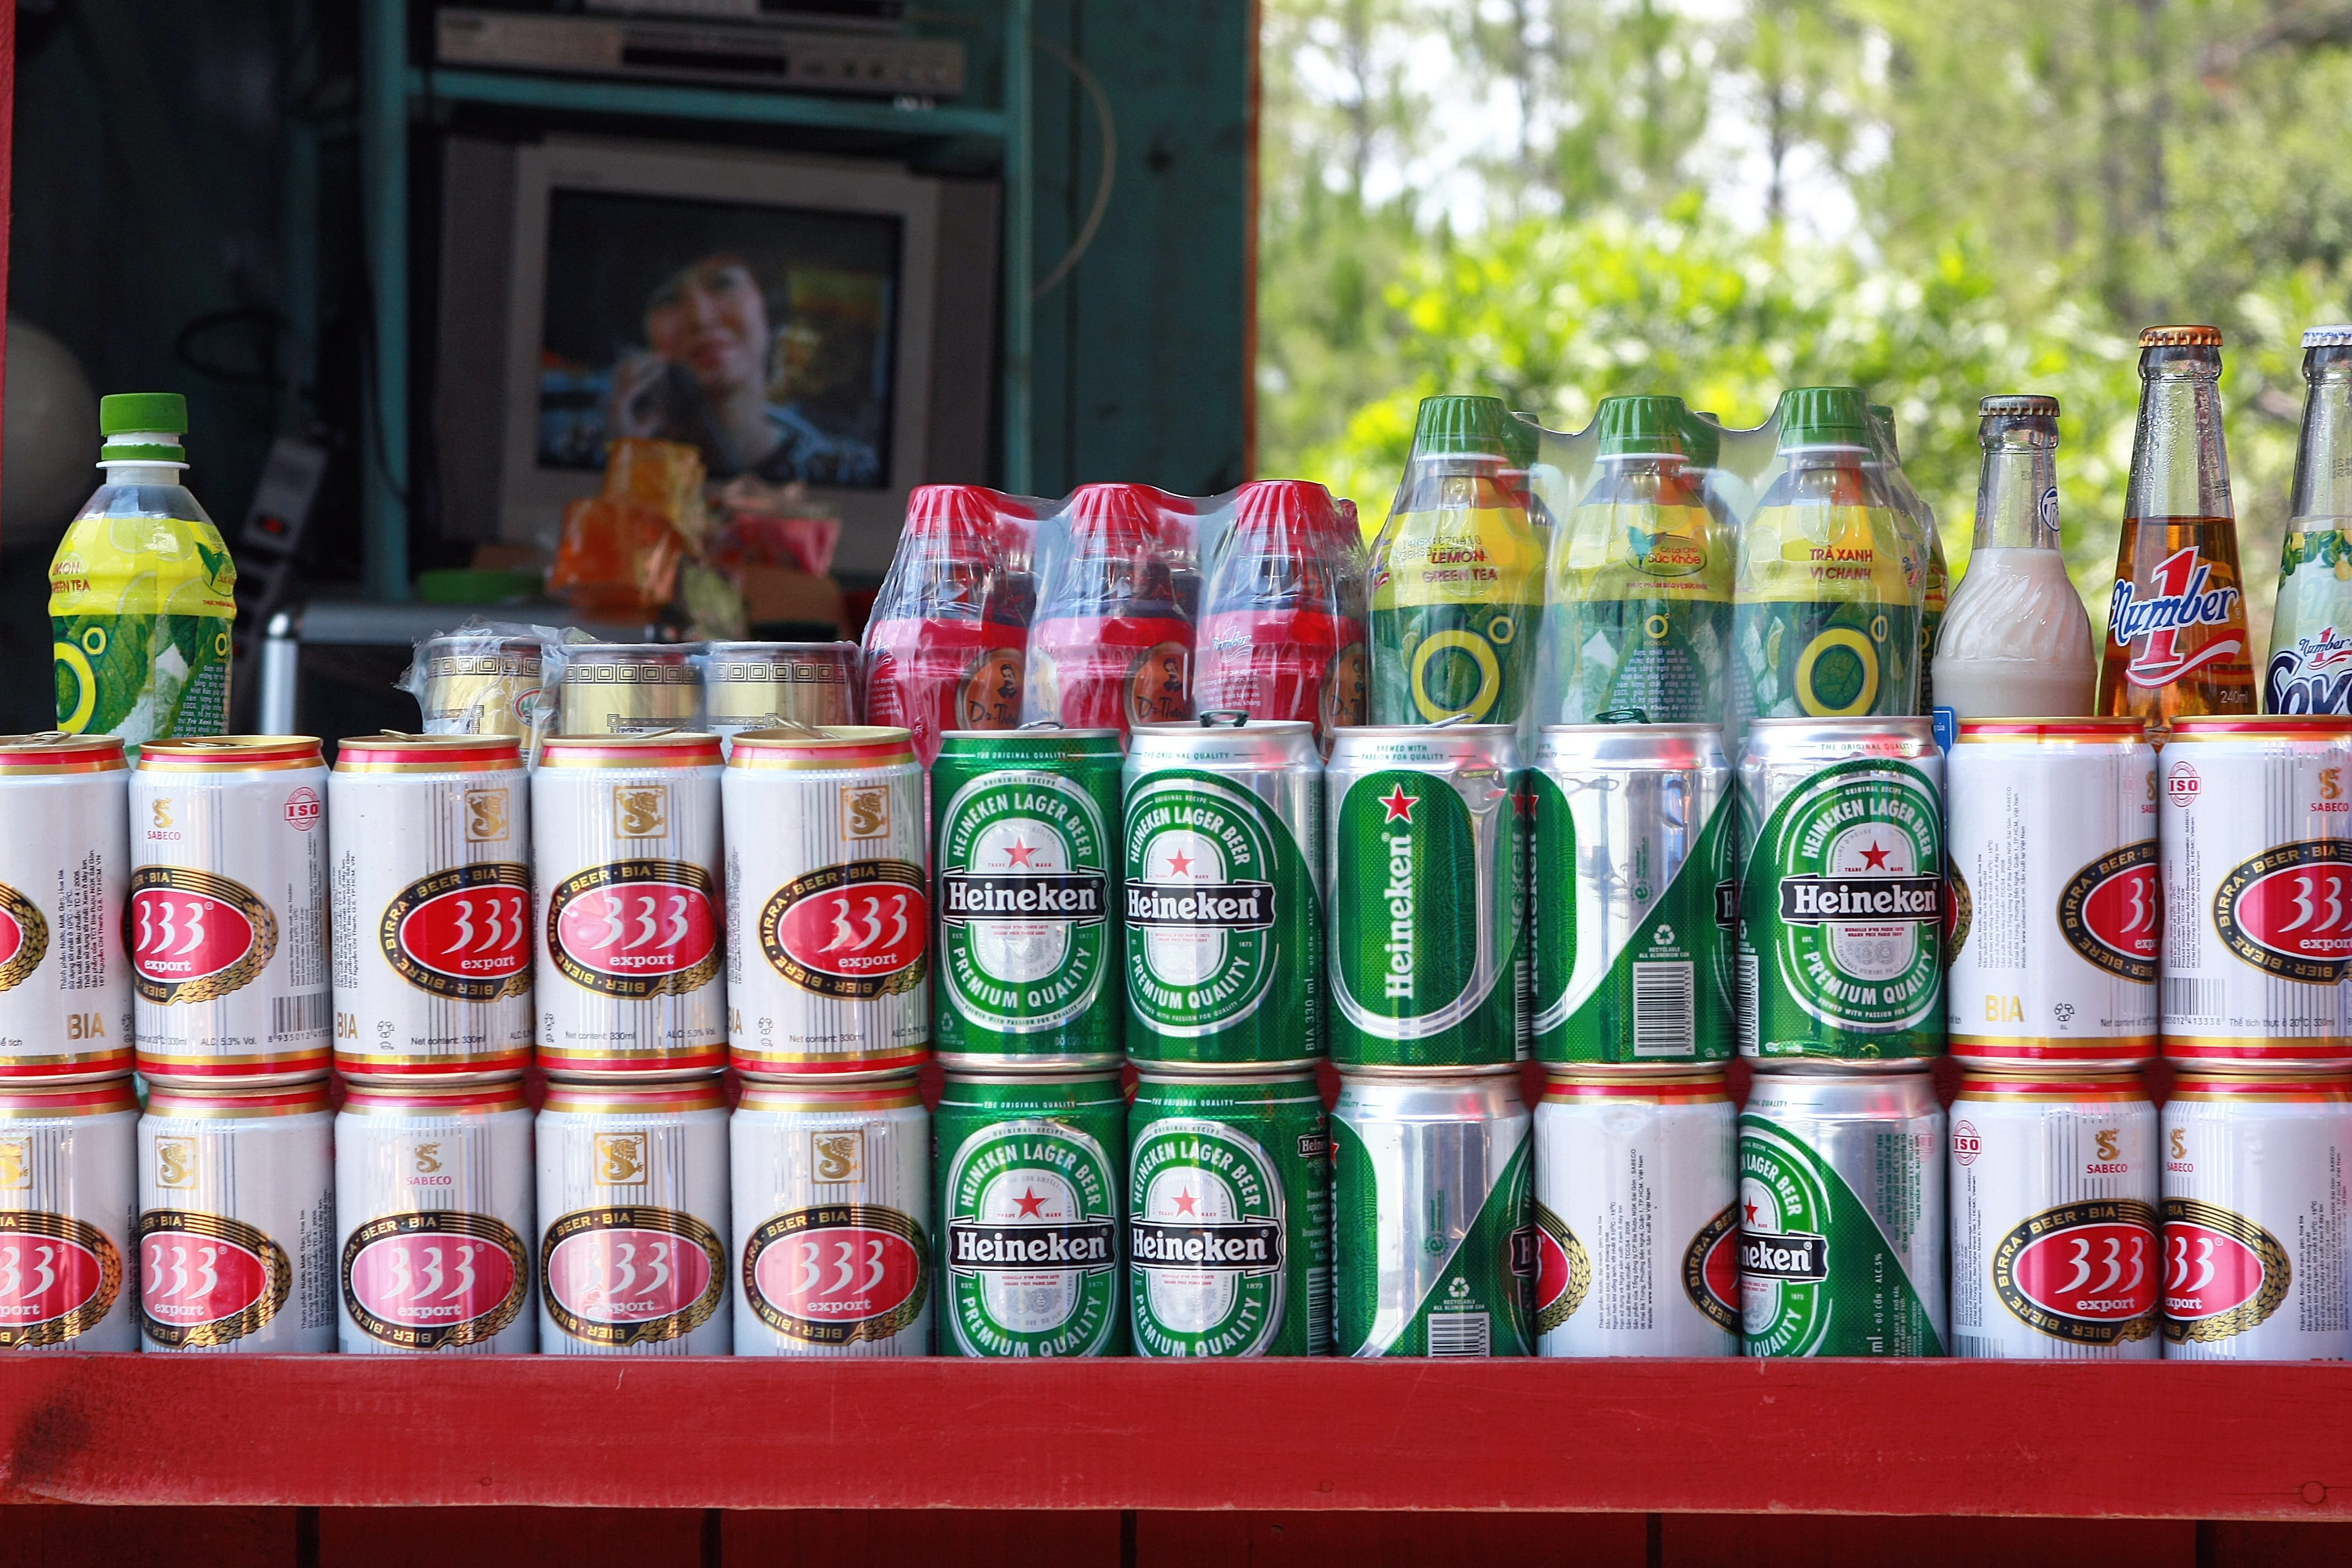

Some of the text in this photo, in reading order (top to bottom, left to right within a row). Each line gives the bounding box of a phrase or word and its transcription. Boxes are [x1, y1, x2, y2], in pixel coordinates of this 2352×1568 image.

[1431, 550, 1487, 563] LEMON
[1810, 545, 1872, 562] TRÀ XANH
[71, 579, 90, 592] TEA
[1423, 568, 1498, 582] GREEN TEA
[1826, 567, 1871, 580] CHANH
[2111, 564, 2239, 647] Number
[2299, 633, 2350, 657] Number
[2221, 690, 2248, 704] 240ml
[2169, 780, 2199, 793] ISO
[288, 803, 319, 818] ISO
[2311, 802, 2349, 812] SABECO
[147, 830, 181, 840] SABECO
[952, 793, 1093, 859] HEINEKEN LAGER BEER
[1130, 807, 1251, 867] HEINEKEN LAGER BEER
[1801, 799, 1932, 859] HEINEKEN LAGER BEER
[150, 872, 170, 884] BIA
[570, 866, 650, 892] BEER BIA
[2067, 851, 2137, 929] BIRRA BEER
[2219, 846, 2338, 927] BIRRA BEER BIA
[385, 868, 497, 950] BIRRA BEER BIA
[763, 866, 875, 948] BIRRA BEER BIA
[949, 881, 1097, 912] Heineken
[1128, 889, 1260, 921] Heineken
[1794, 884, 1937, 914] Heineken
[137, 901, 204, 956] 333
[441, 896, 524, 954] 333
[590, 893, 688, 950] 333
[818, 894, 907, 953] 333
[1383, 834, 1413, 1000] Heineken
[144, 959, 192, 972] export
[461, 956, 515, 970] export
[609, 954, 674, 968] export
[839, 953, 897, 968] export
[2232, 937, 2332, 977] BIERE BIER
[774, 957, 873, 993] BIERE BIER
[954, 946, 1092, 1009] PREMIUM QUALITY
[1133, 954, 1251, 1010] PREMIUM QUALITY
[1803, 950, 1934, 1006] PREMIUM QUALITY
[1305, 977, 1315, 1052] BIA 330 ml
[1985, 995, 2025, 1022] BIA
[67, 1013, 105, 1039] BIA
[337, 1012, 358, 1039] BIA
[1954, 1138, 1979, 1151] ISO
[406, 1175, 451, 1185] SABECO
[960, 1143, 1101, 1207] HEINEKEN LAGER BEER
[1134, 1141, 1260, 1208] HEINEKEN LAGER BEER
[2087, 1164, 2127, 1173] SABECO
[2167, 1163, 2193, 1172] SABECO
[1746, 1156, 1802, 1217] LAGER BEER
[160, 1216, 182, 1227] BIA
[361, 1217, 437, 1241] BEER BIA
[556, 1213, 631, 1237] BEER BIA
[766, 1211, 847, 1238] BEER BIA
[956, 1232, 1107, 1262] Heineken
[1132, 1228, 1267, 1261] Heineken
[1999, 1206, 2115, 1288] BIRRA BEER BIA
[146, 1244, 218, 1299] 333
[379, 1245, 476, 1301] 333
[573, 1241, 668, 1296] 333
[787, 1239, 884, 1296] 333
[1689, 1236, 1711, 1288] BIRRA
[2055, 1237, 2144, 1294] 333
[154, 1302, 204, 1316] export
[396, 1303, 461, 1318] export
[807, 1298, 871, 1312] export
[2010, 1296, 2111, 1338] BIERE BIER
[2076, 1298, 2135, 1310] export
[393, 1329, 431, 1343] BIER
[802, 1325, 842, 1338] BIER
[1866, 1337, 1883, 1353] ml
